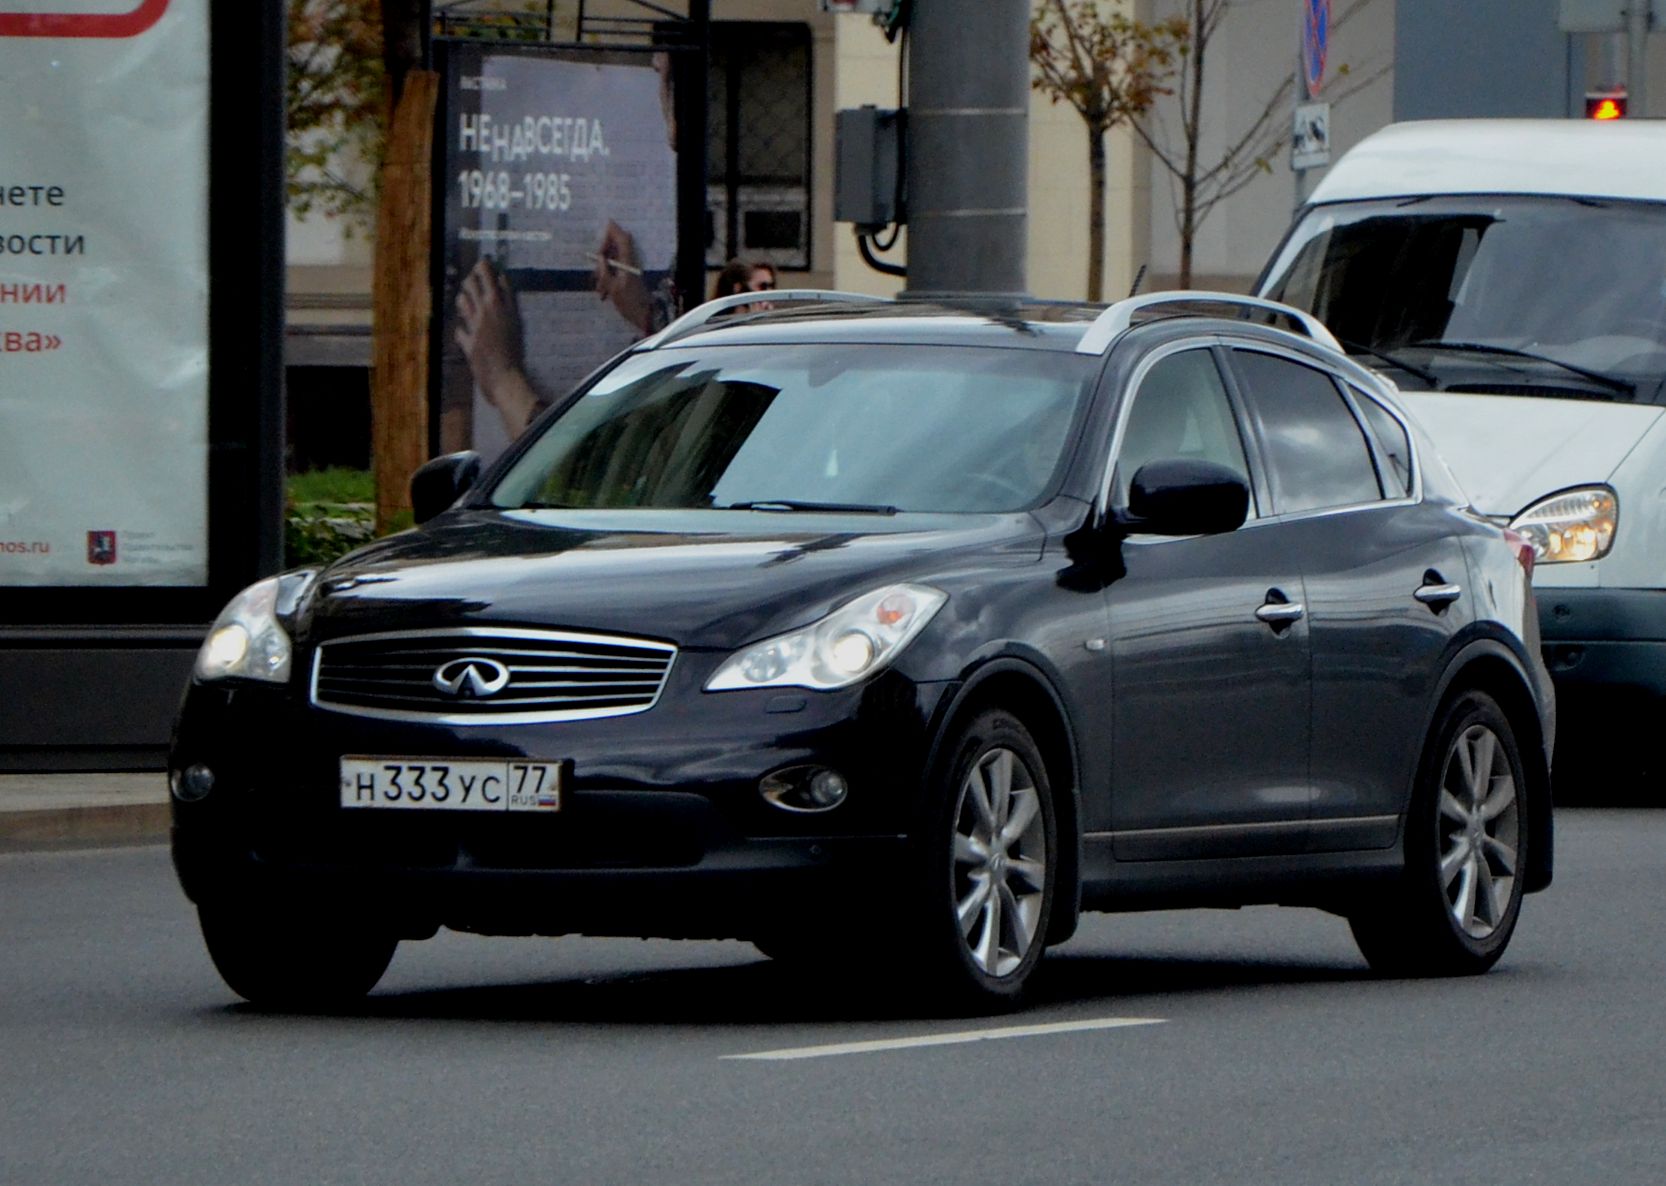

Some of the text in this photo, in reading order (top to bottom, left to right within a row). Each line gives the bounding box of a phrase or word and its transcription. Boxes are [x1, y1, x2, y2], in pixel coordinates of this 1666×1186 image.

[0, 331, 62, 352] ва»
[512, 765, 547, 794] 77
[511, 795, 536, 806] RUS
